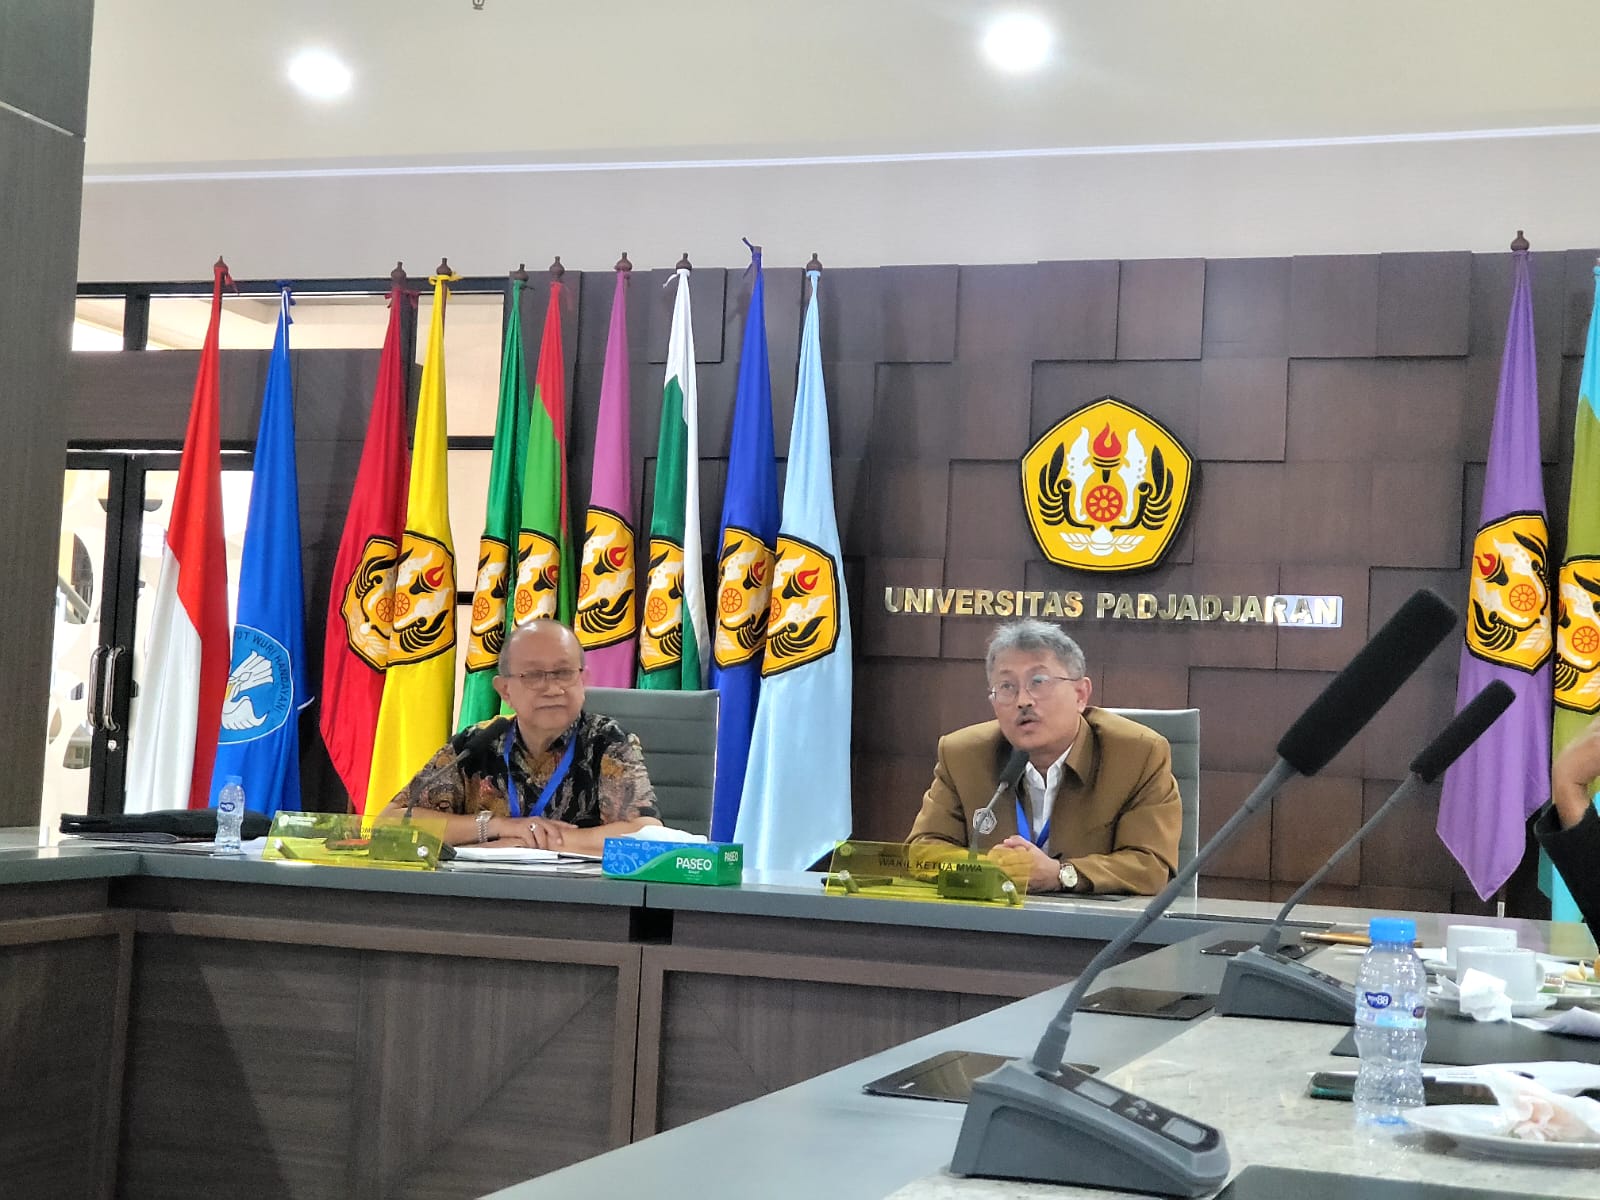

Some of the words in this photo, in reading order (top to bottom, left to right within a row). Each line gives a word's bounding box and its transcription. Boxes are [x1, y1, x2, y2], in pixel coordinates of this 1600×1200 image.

[884, 586, 1084, 619] UNIVERSITAS
[1096, 592, 1340, 626] PADJADJARAN
[253, 635, 276, 655] WURI
[274, 656, 289, 712] HANDAYANI
[676, 856, 713, 871] PASEO
[724, 851, 738, 862] PASEO
[879, 857, 912, 869] WAKIL
[916, 861, 952, 872] KETUA
[956, 863, 983, 873] MWA
